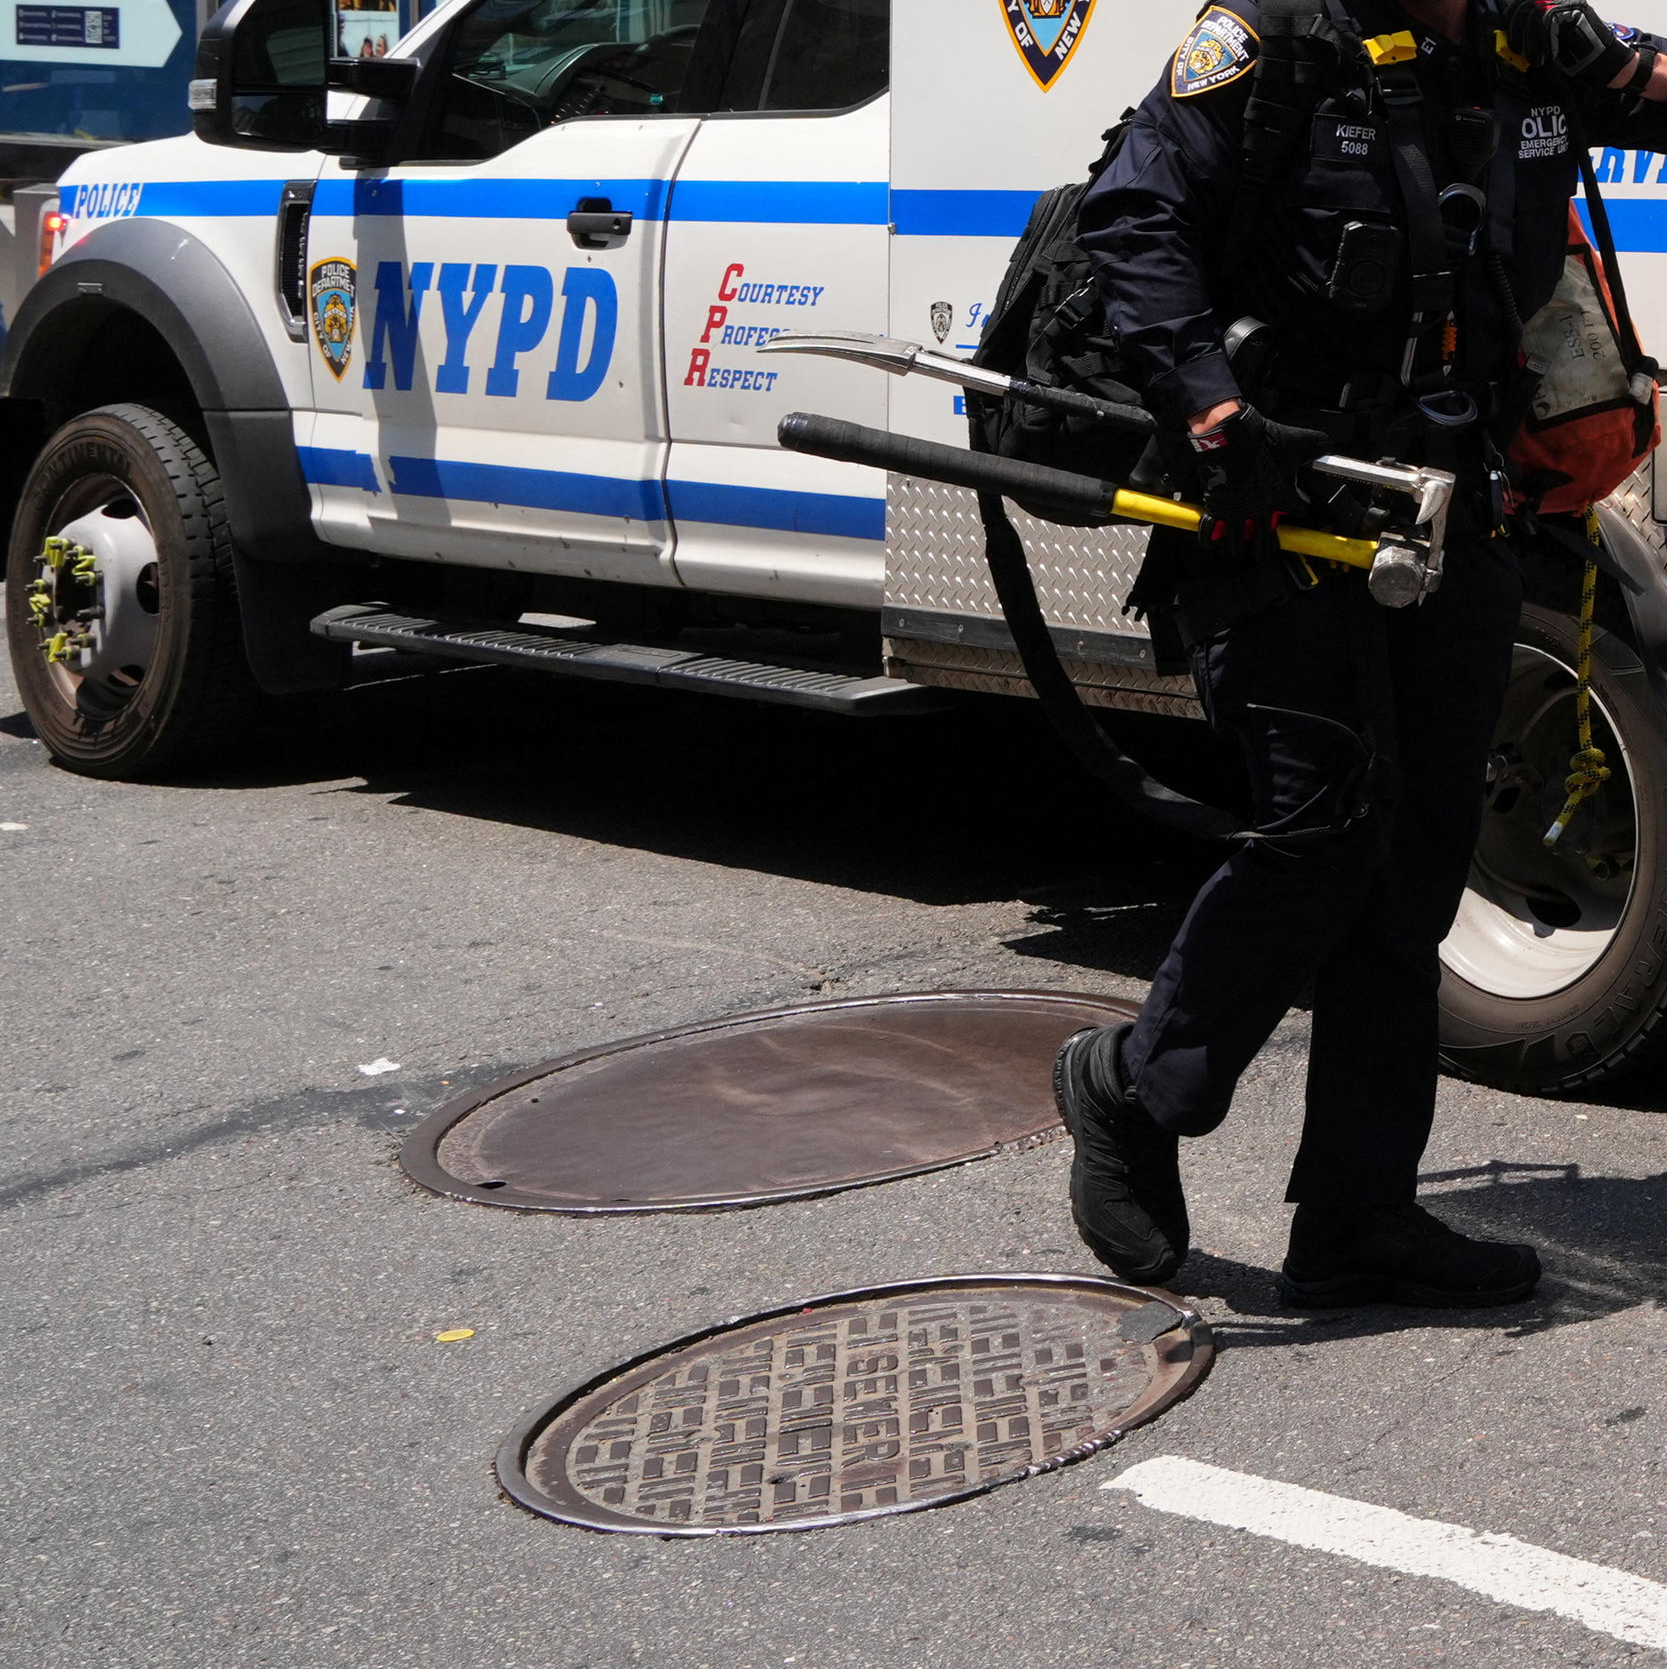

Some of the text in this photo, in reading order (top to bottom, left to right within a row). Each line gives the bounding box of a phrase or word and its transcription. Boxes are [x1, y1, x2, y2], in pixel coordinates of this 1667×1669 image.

[1015, 21, 1034, 48] OF
[1054, 11, 1082, 61] NEW
[1201, 19, 1249, 62] DEPARTMENT
[1217, 15, 1249, 44] POLICE
[1187, 65, 1241, 91] NEW YORK
[1531, 105, 1561, 117] NYPD
[1336, 124, 1376, 140] KIEFER
[1521, 114, 1568, 138] OLIC
[1341, 141, 1369, 155] 5088
[1518, 146, 1555, 159] SERVICE
[74, 183, 142, 219] POLICE
[321, 262, 351, 279] POLICE
[718, 263, 824, 306] COURTESY
[363, 261, 619, 402] NYPD
[684, 348, 778, 392] RESPECT
[841, 1354, 899, 1468] SEWER
